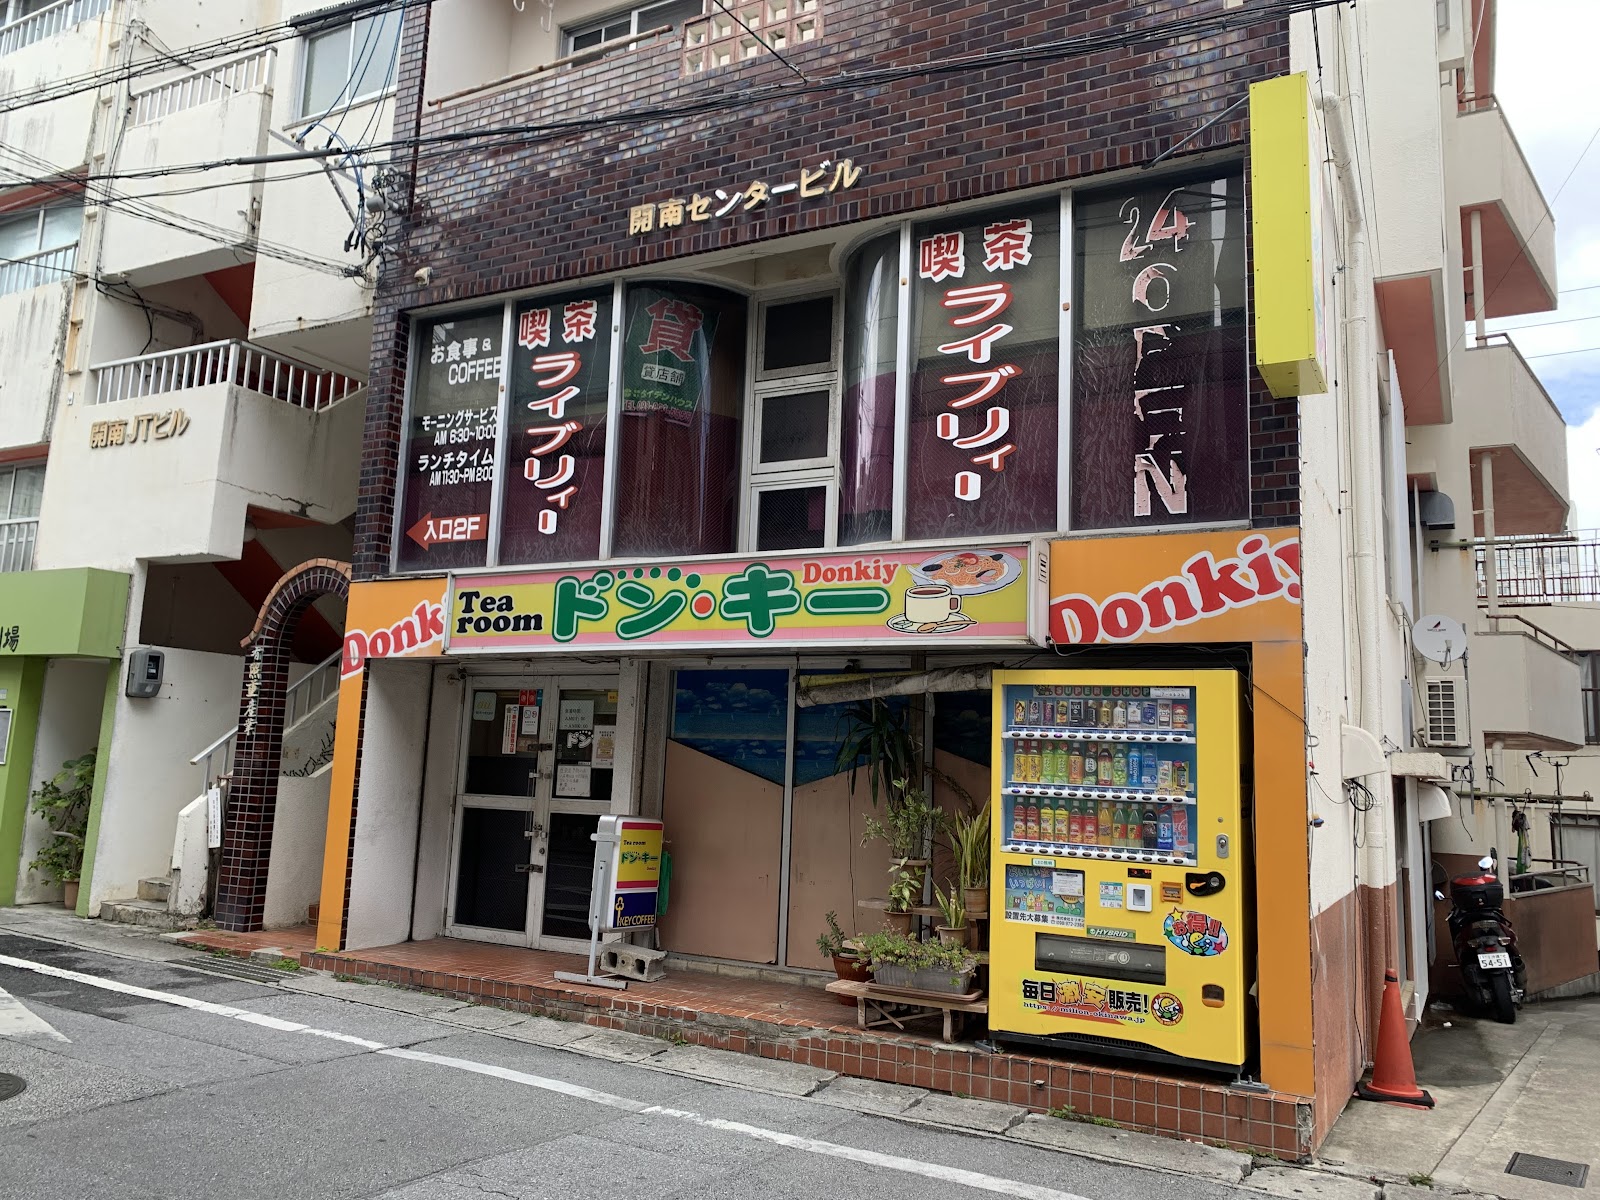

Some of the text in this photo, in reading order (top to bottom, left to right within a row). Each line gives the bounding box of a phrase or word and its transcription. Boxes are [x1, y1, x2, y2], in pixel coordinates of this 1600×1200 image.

[629, 159, 862, 236] 開南センタービル
[919, 219, 1032, 283] 喫茶
[518, 301, 598, 350] 喫茶
[639, 297, 704, 362] 貸
[430, 337, 478, 365] お食事
[448, 356, 501, 386] COFFEE
[642, 364, 685, 385] 貸店舗
[421, 405, 498, 431] モーニングサービス
[433, 430, 448, 446] AM
[418, 448, 494, 471] ランチタイム
[423, 516, 481, 541] 入口2F
[802, 557, 899, 585] Donkiy
[458, 590, 514, 614] Tea
[456, 612, 544, 634] room
[1095, 928, 1128, 938] HYBRID
[1481, 958, 1508, 968] 54-51
